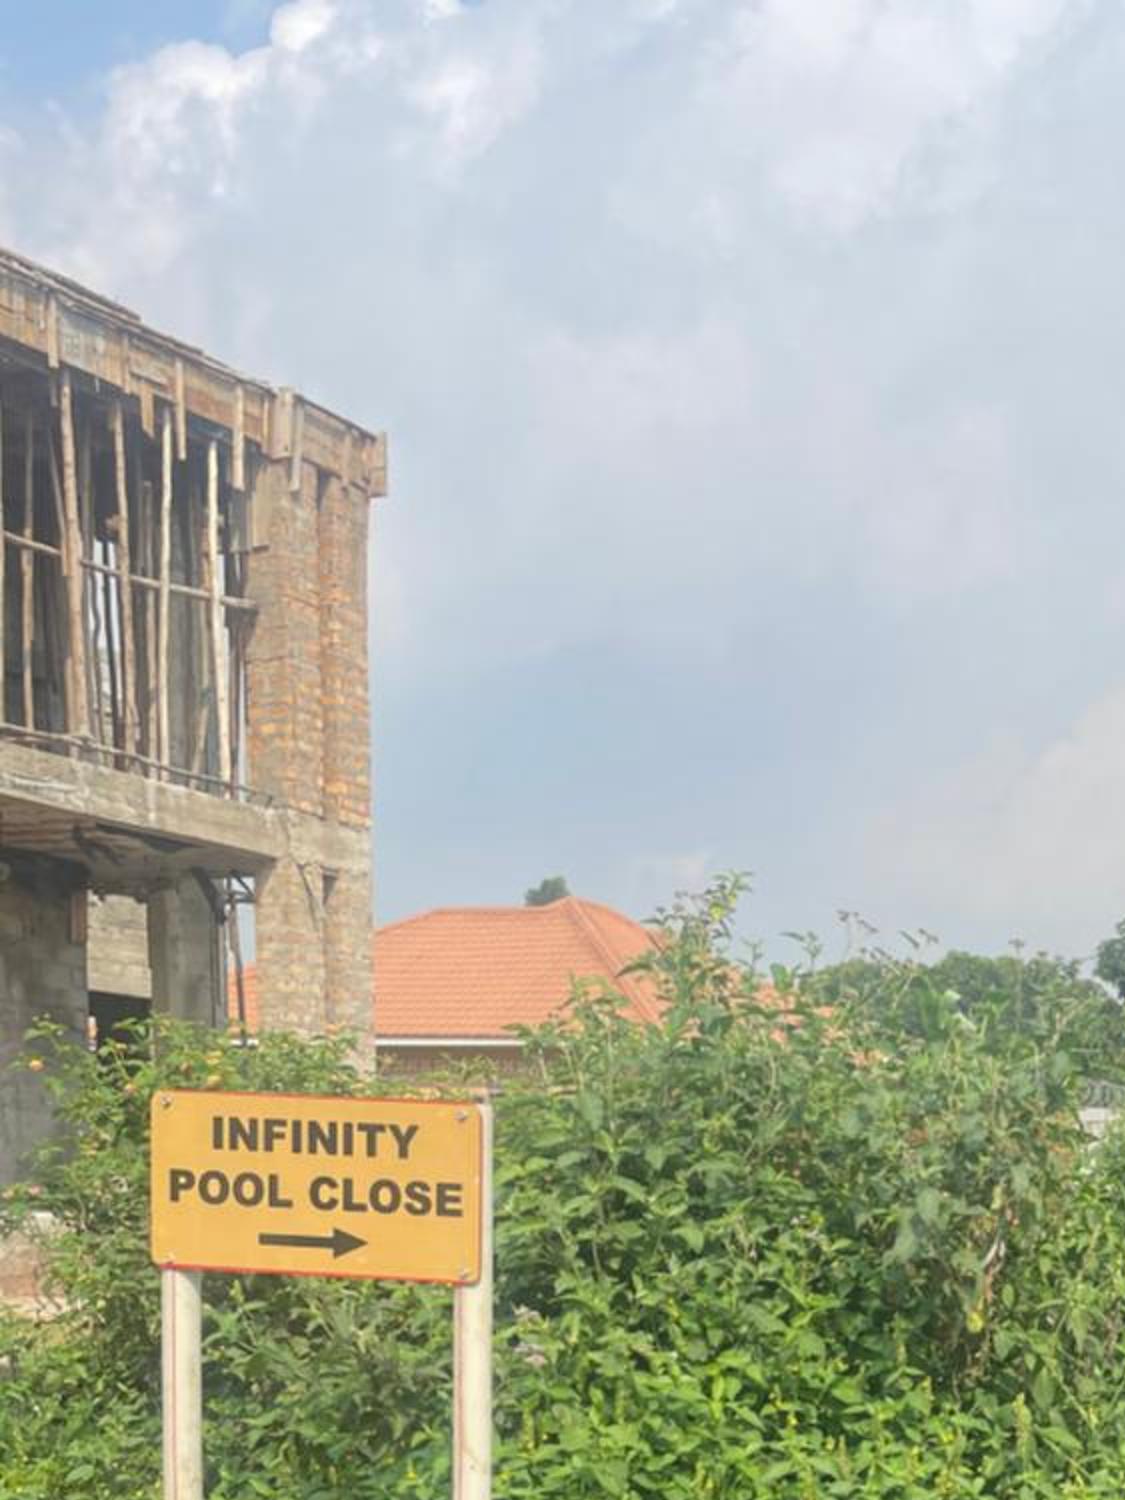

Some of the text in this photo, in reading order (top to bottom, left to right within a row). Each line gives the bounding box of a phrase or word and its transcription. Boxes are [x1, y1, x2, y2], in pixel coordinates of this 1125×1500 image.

[211, 1116, 419, 1159] INFINITY
[169, 1168, 463, 1217] POOL CLOSE
